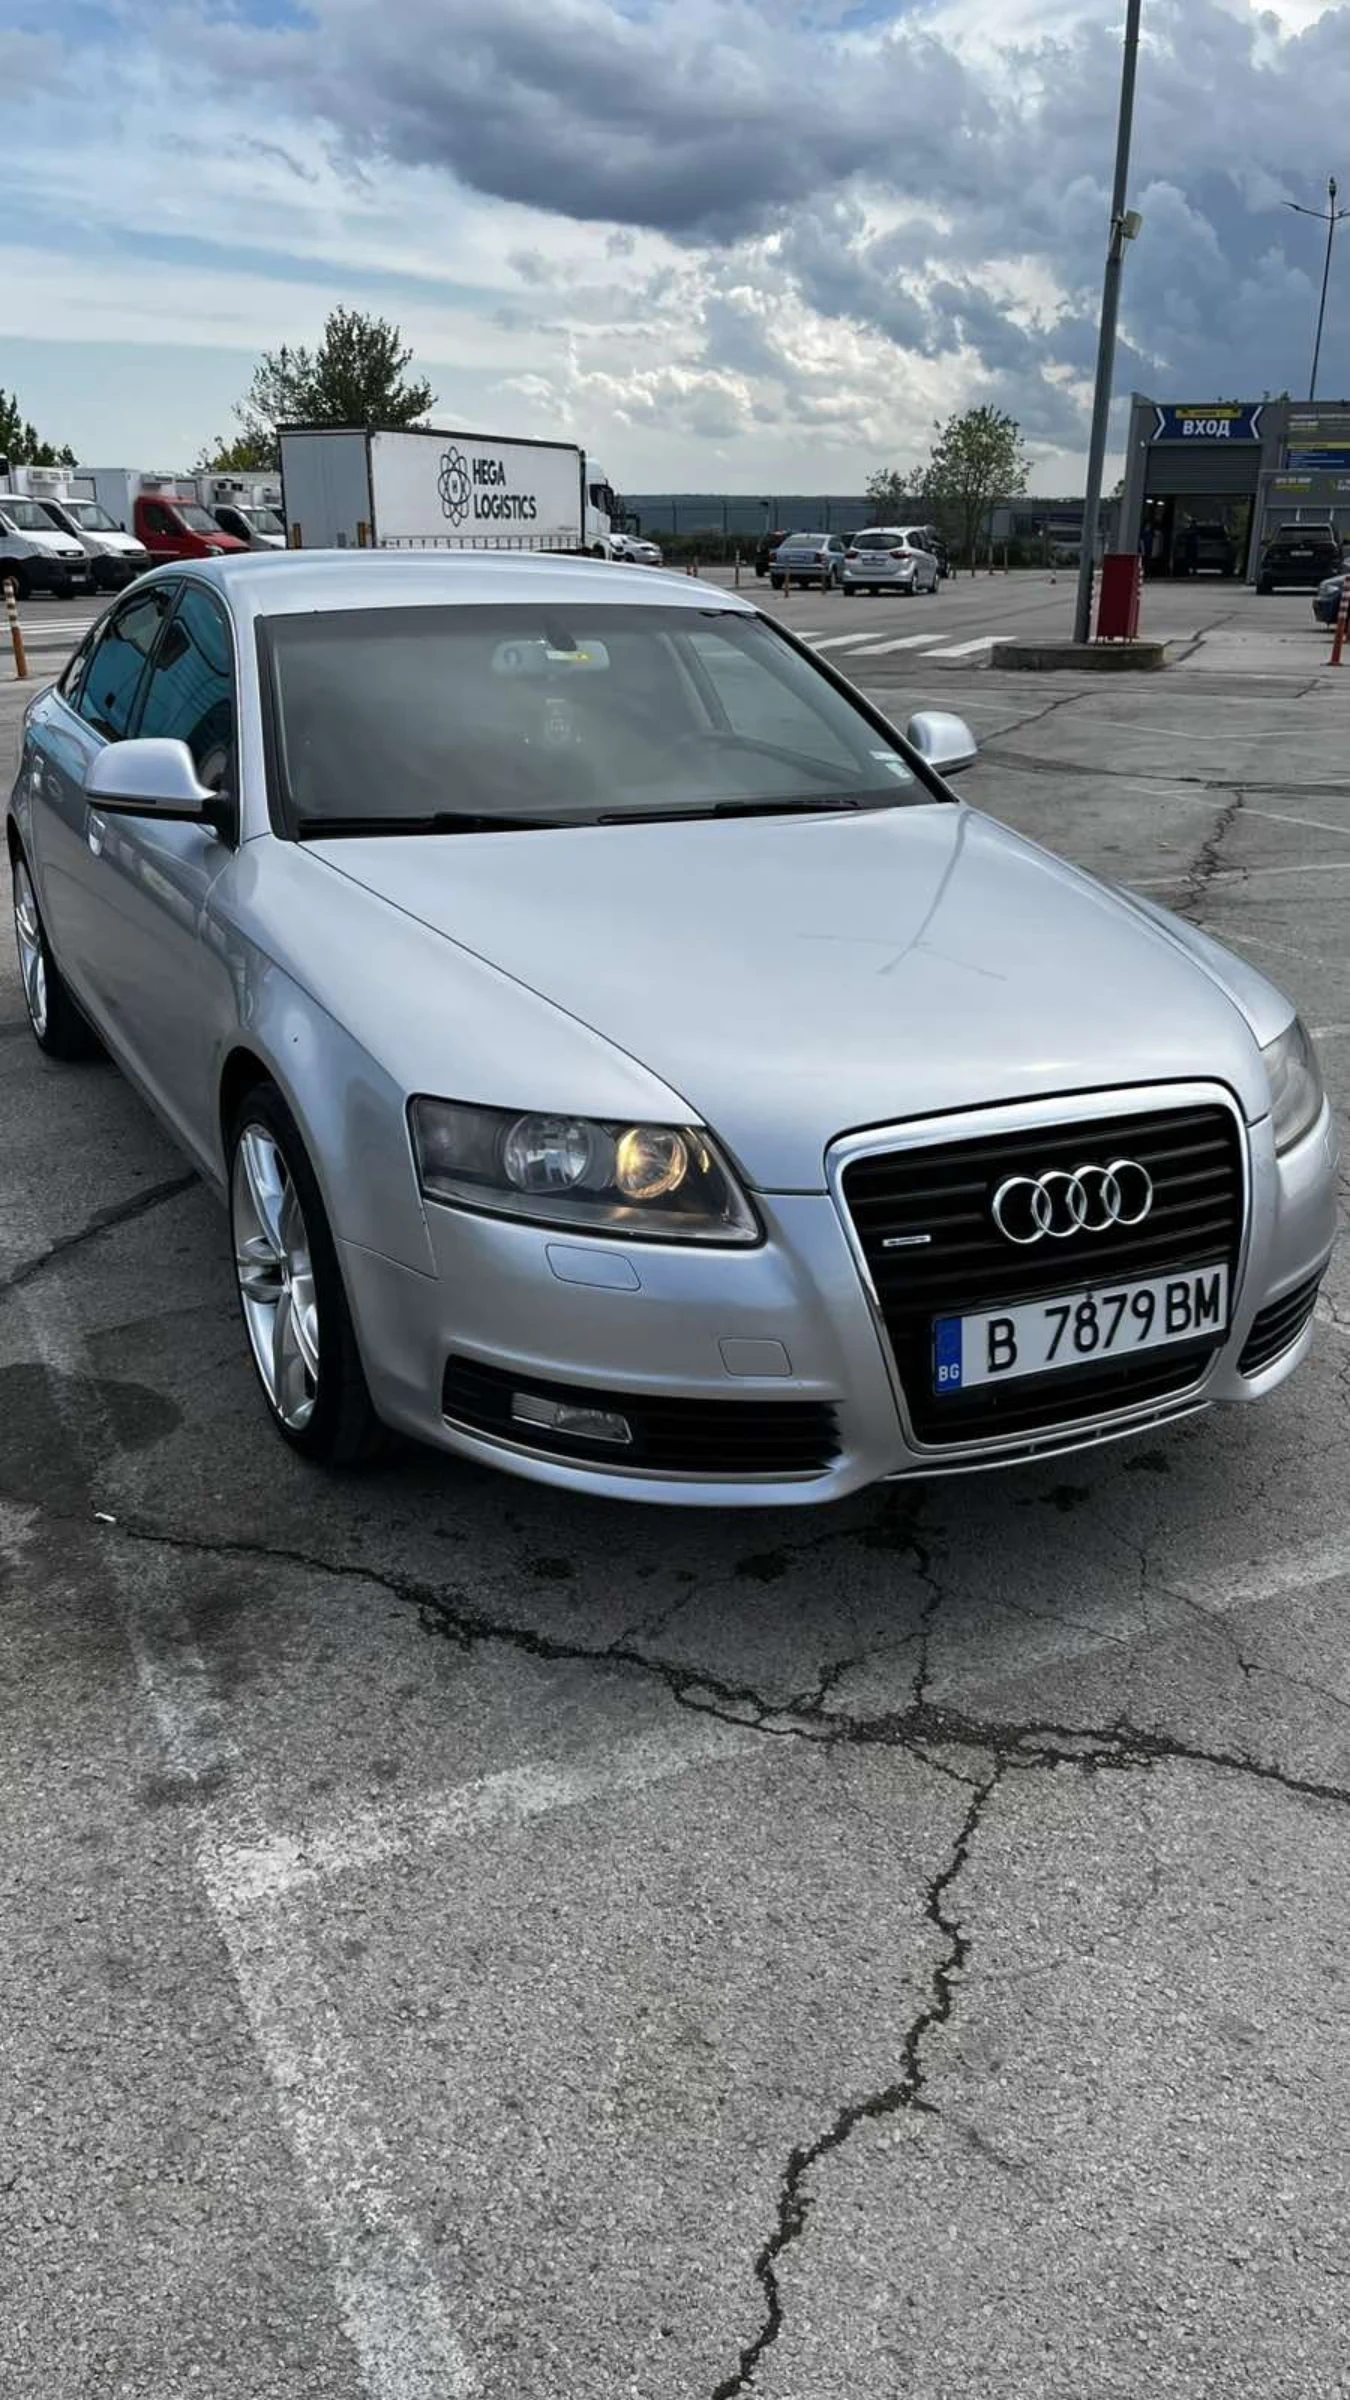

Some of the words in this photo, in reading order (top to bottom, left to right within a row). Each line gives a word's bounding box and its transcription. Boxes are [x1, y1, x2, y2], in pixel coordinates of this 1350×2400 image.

[1182, 419, 1231, 438] ВХОД
[472, 457, 506, 486] HEGA
[474, 494, 537, 520] LOGISTICS
[987, 1317, 1018, 1373] B
[1044, 1289, 1156, 1362] 7879
[1165, 1272, 1221, 1335] BM
[938, 1363, 960, 1382] BG
